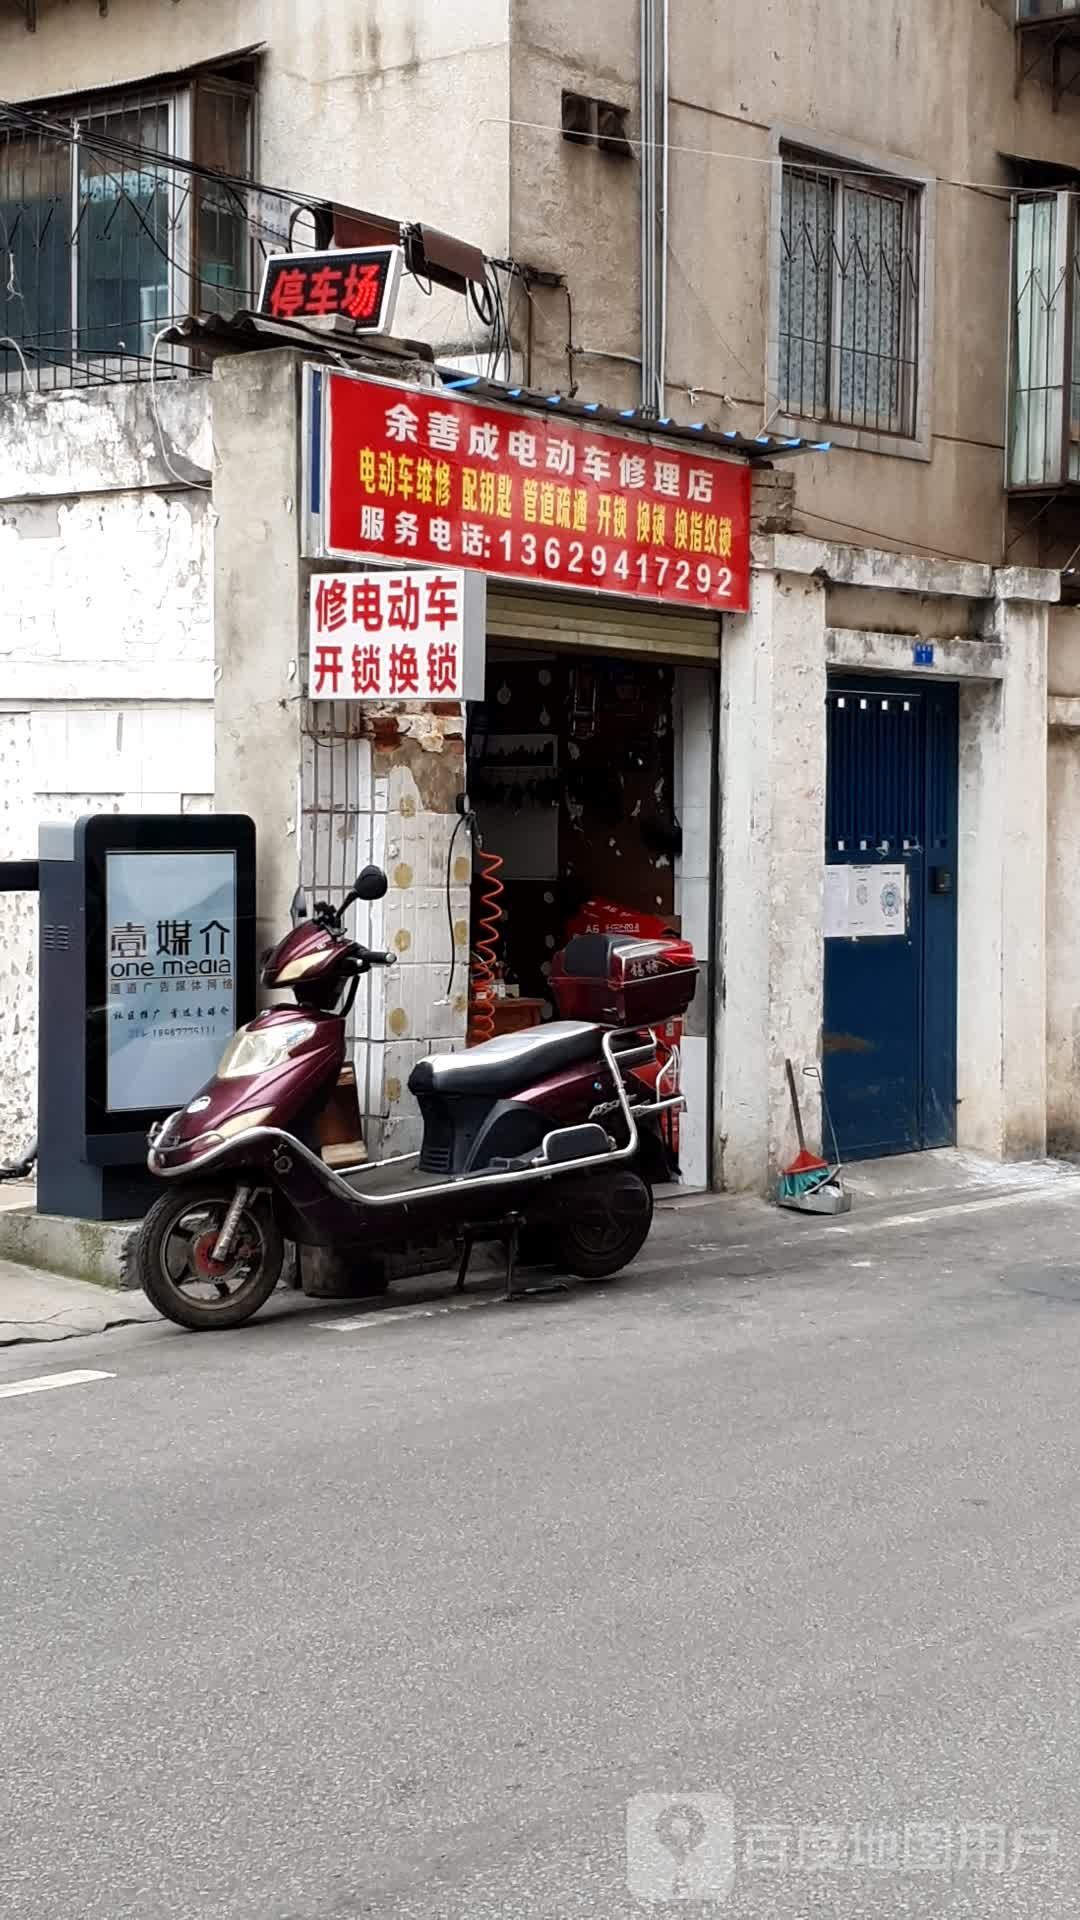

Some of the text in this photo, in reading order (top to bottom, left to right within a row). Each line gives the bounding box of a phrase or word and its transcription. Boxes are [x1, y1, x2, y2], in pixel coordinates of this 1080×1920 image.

[270, 264, 380, 319] 停车场
[384, 403, 713, 504] 余善成电动车修理店
[359, 447, 732, 558] 电动车维修 配钥匙 管道疏通 开锁 换锁 换指纹锁
[315, 574, 459, 633] 修电动车
[313, 641, 458, 694] 开锁换锁
[111, 920, 231, 959] 壹媒介
[110, 959, 231, 978] one media
